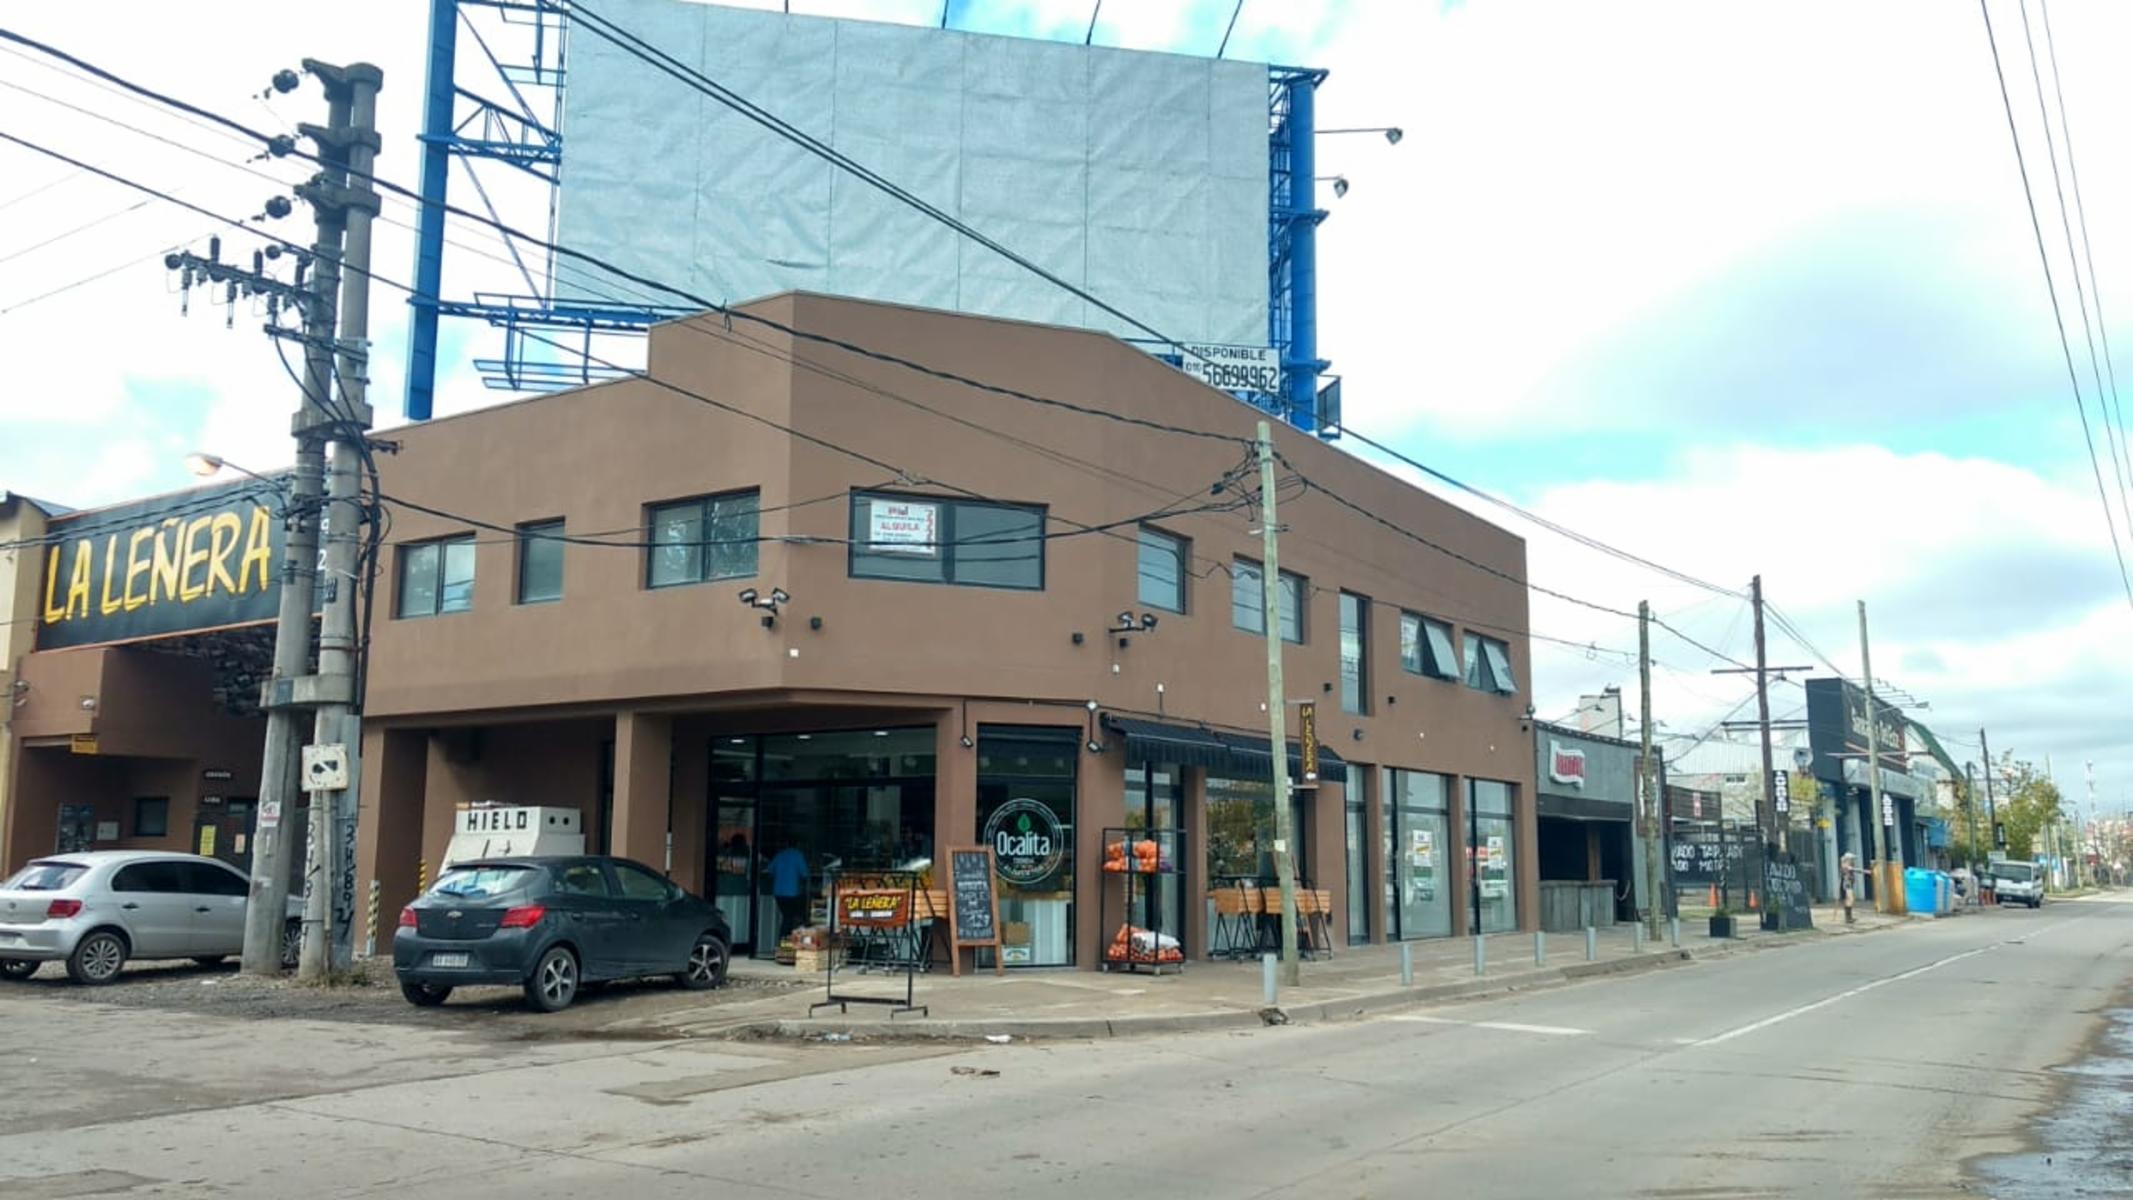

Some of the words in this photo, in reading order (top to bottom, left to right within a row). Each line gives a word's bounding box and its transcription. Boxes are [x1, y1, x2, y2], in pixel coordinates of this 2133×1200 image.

[1190, 345, 1267, 361] DISPONIBLE
[1203, 363, 1278, 390] 56699962
[44, 538, 93, 624] LA
[101, 505, 271, 616] LEÑERA
[467, 810, 529, 832] HIELO
[997, 831, 1051, 856] Ocalita
